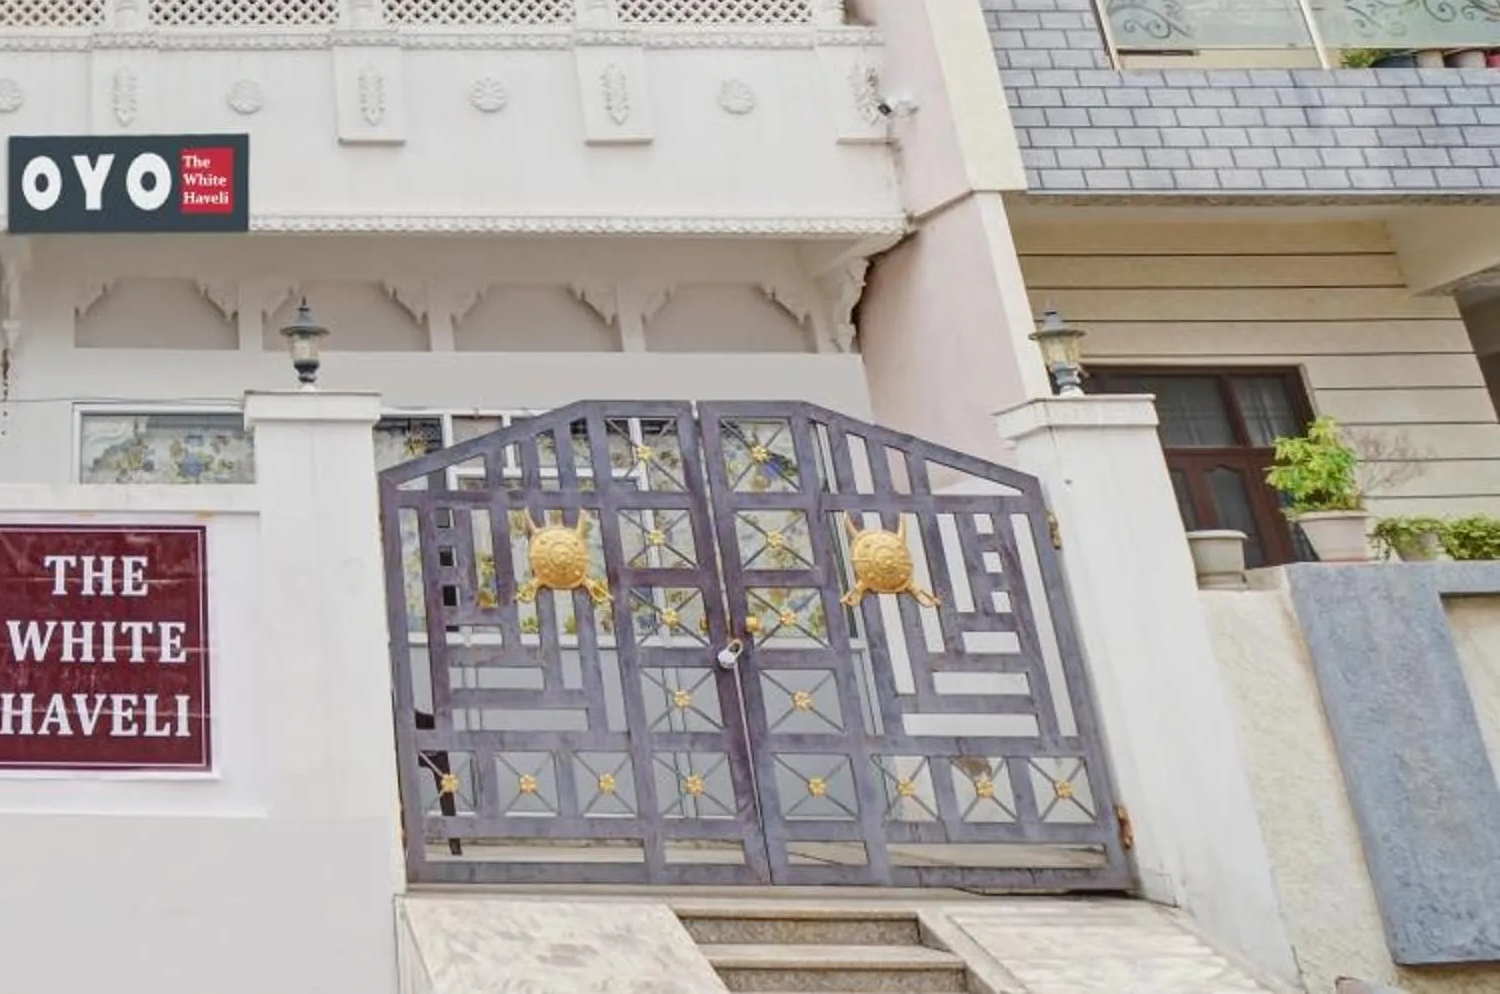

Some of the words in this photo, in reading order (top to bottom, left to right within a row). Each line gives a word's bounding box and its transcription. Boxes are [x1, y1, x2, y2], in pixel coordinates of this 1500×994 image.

[21, 152, 172, 211] OYO
[182, 155, 211, 169] The
[183, 173, 227, 186] White
[182, 190, 229, 205] Haveli
[44, 555, 149, 596] THE
[6, 620, 187, 663] WHITE
[0, 692, 191, 737] HAVELI
